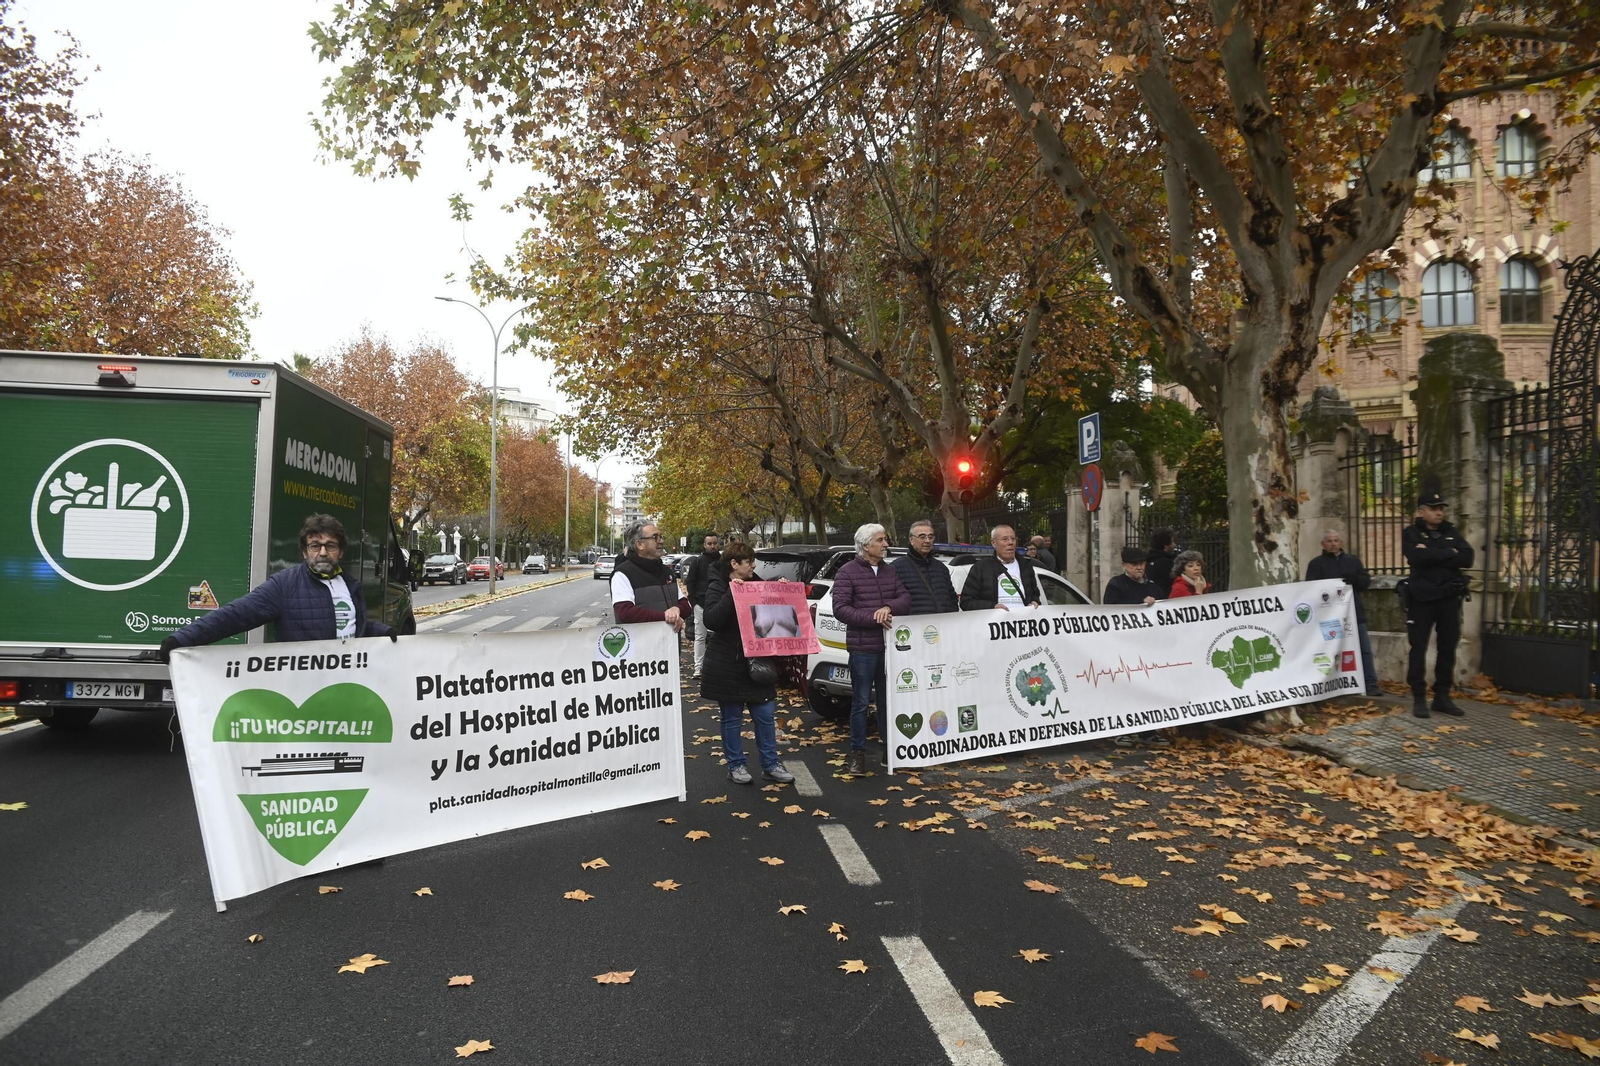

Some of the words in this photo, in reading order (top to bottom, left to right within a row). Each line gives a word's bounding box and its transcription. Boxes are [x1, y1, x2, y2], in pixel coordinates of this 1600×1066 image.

[1083, 421, 1095, 457] P
[284, 437, 357, 485] MERCADONA
[283, 479, 356, 509] www.mercadona.es
[734, 584, 744, 594] NO
[746, 584, 756, 593] ES
[152, 615, 192, 625] Somos
[988, 618, 1050, 641] DINERO
[1052, 612, 1110, 635] PÚBLICO
[1111, 612, 1154, 631] PARA
[1156, 603, 1221, 626] SANIDAD
[1222, 596, 1285, 618] PÚBLICA
[1226, 625, 1247, 634] ANDALUZA
[1254, 626, 1272, 636] MAREAS
[748, 640, 764, 651] SON
[766, 639, 783, 650] TUS
[247, 653, 352, 672] DEFIENDE
[356, 652, 368, 669] !!
[75, 684, 111, 697] 3372
[115, 685, 141, 698] MGW
[416, 669, 555, 701] Plataforma
[561, 667, 586, 685] en
[592, 659, 669, 682] Defensa
[410, 712, 452, 741] del
[460, 700, 558, 735] Hospital
[564, 697, 590, 721] de
[595, 687, 674, 717] Montilla
[896, 731, 1007, 760] COORDINADORA
[1009, 728, 1026, 745] EN
[1029, 720, 1087, 742] DEFENSA
[1088, 717, 1106, 733] DE
[1107, 715, 1126, 730] LA
[1126, 706, 1180, 727] SANIDAD
[1179, 699, 1231, 719] PÚBLICA
[1231, 695, 1256, 711] DEL
[1258, 689, 1290, 706] ÁREA
[1288, 684, 1310, 698] SUR
[1311, 682, 1323, 696] DE
[266, 719, 374, 736] HOSPITAL!!
[430, 758, 448, 781] y
[455, 749, 481, 773] la
[488, 732, 581, 769] Sanidad
[587, 724, 660, 753] Pública
[429, 761, 661, 813] plat.sanidadhospitalmontilla@gmail.com
[260, 796, 338, 817] SANIDAD
[265, 817, 337, 839] PÚBLICA
